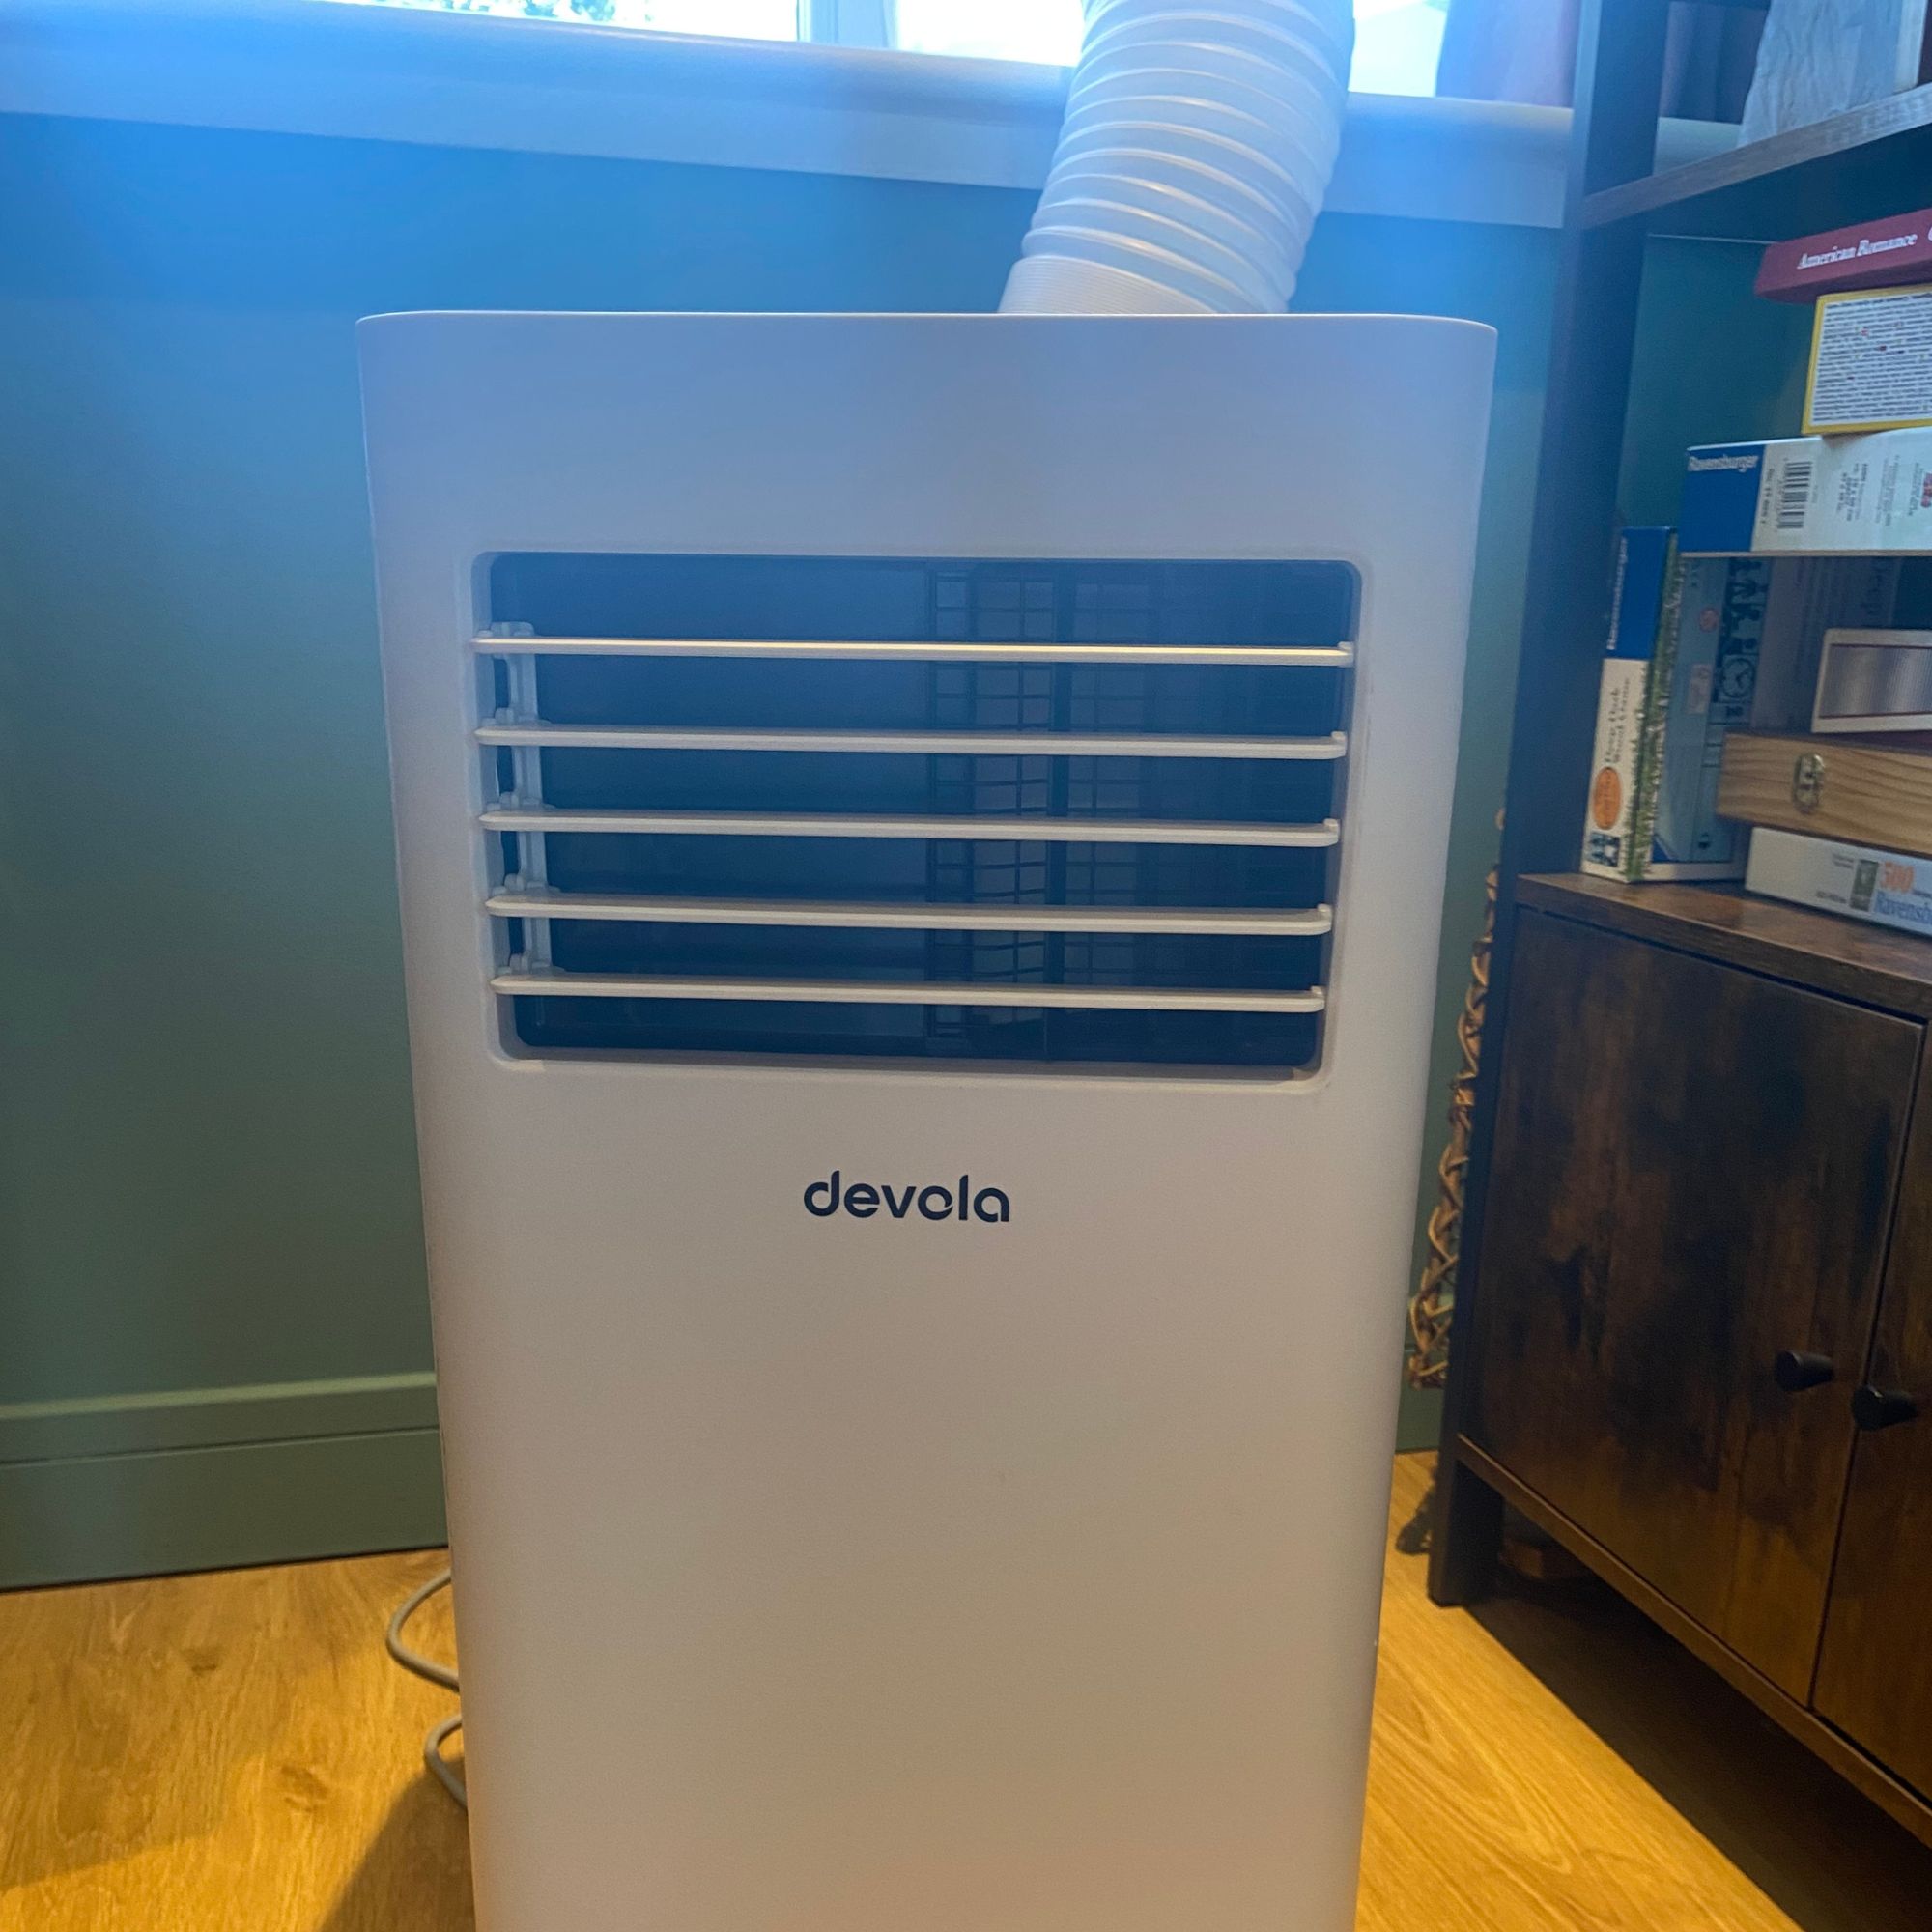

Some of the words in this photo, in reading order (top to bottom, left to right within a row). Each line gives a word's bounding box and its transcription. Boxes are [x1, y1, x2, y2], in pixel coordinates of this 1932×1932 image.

[1797, 245, 1856, 269] American
[1856, 234, 1918, 256] Romance
[804, 1170, 1009, 1222] devola
